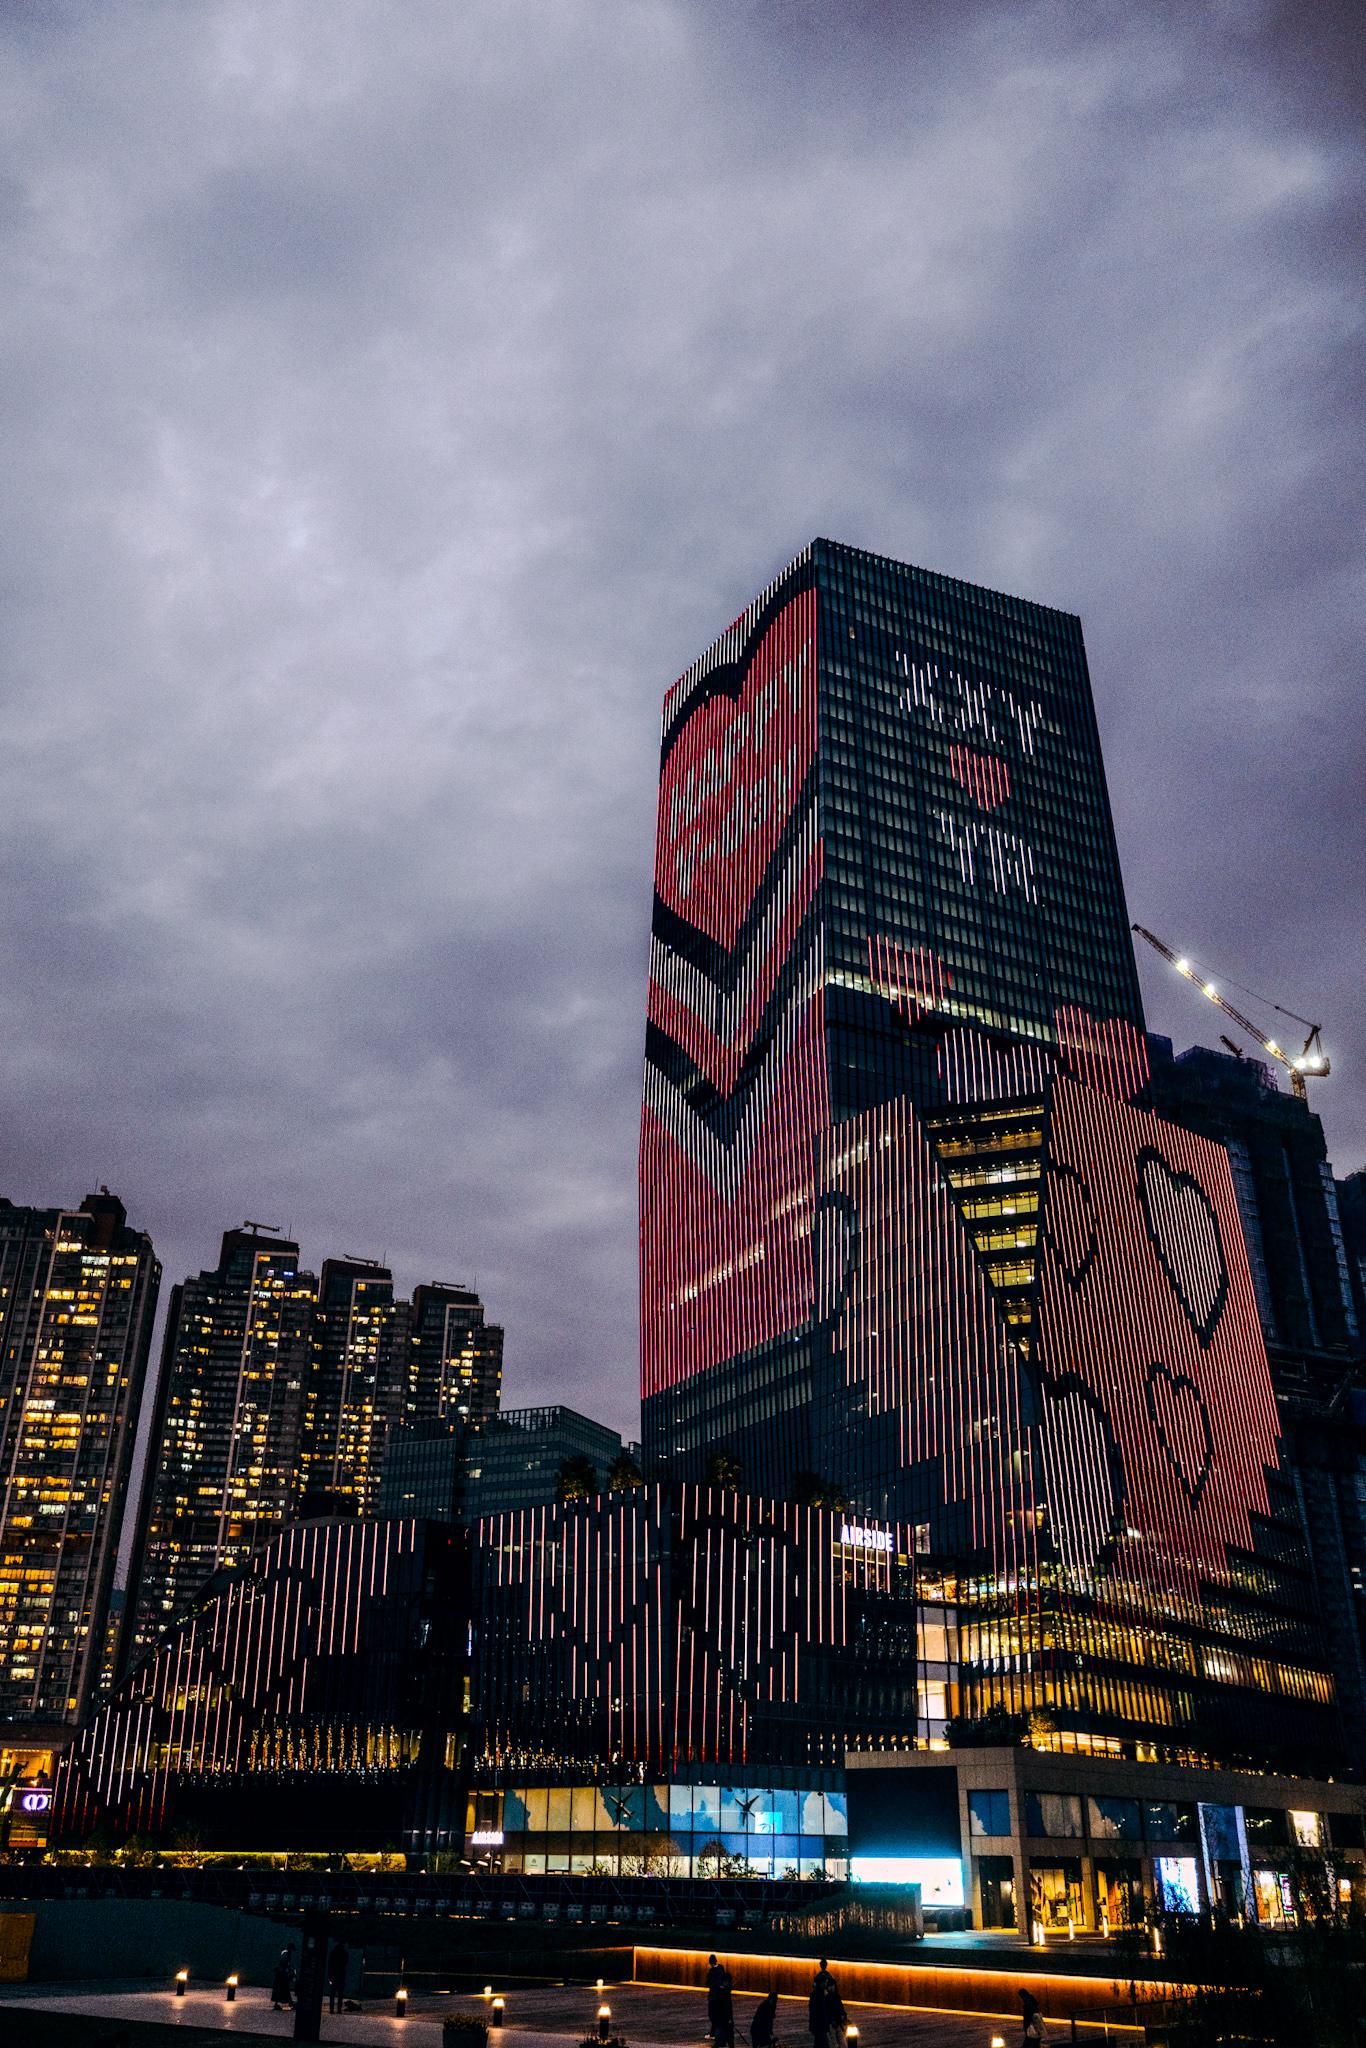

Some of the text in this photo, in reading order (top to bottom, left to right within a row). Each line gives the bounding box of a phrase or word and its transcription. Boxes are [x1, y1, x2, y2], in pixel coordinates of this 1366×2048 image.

[669, 637, 810, 844] HAPPY
[896, 651, 1042, 755] XXY
[841, 1525, 893, 1552] AIRSIDE
